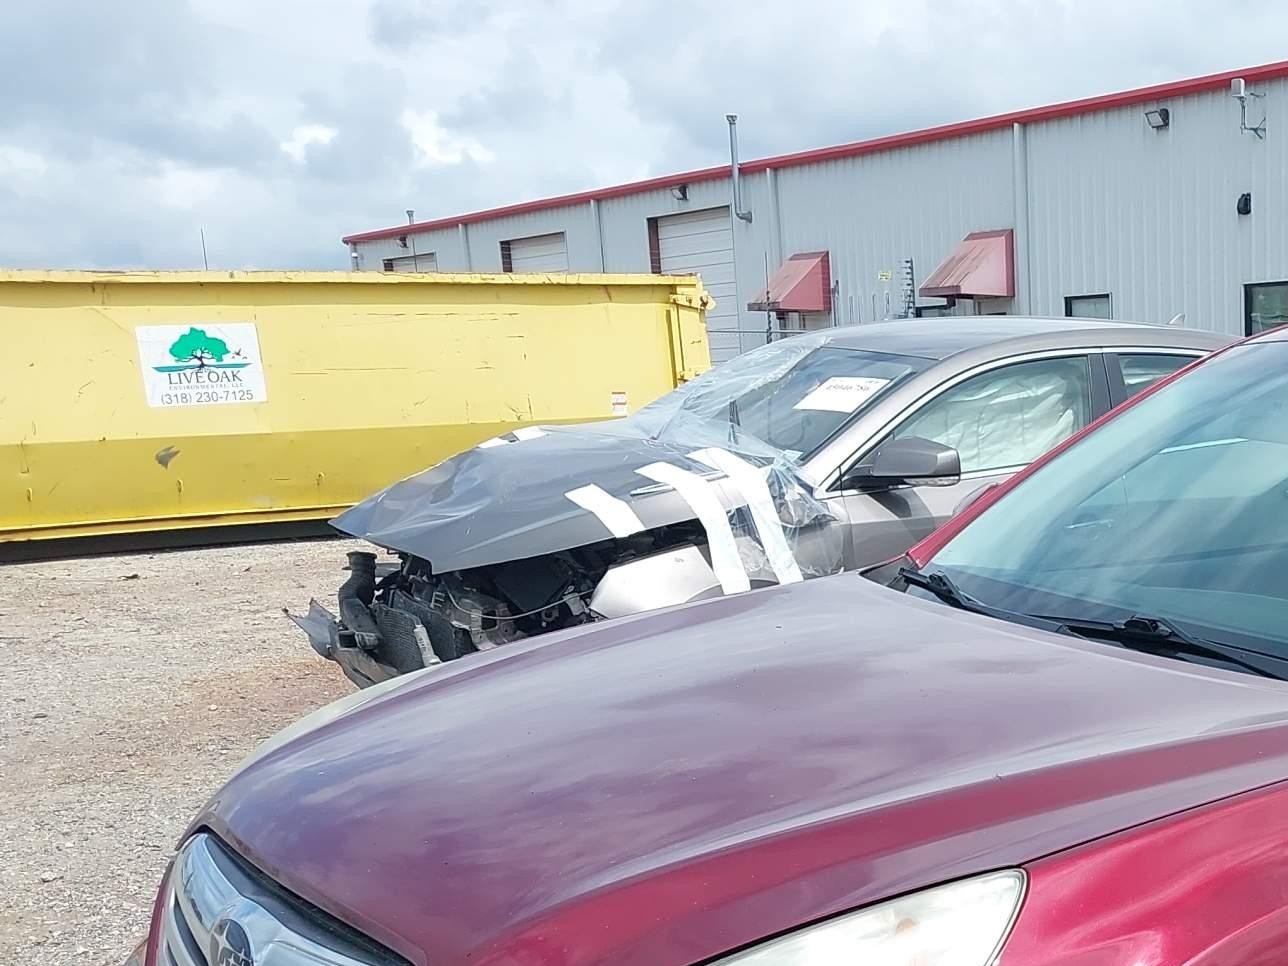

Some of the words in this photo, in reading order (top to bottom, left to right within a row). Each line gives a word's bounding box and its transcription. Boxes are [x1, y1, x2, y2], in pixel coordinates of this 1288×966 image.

[168, 371, 206, 385] LIVE
[207, 369, 243, 384] OAK
[161, 392, 192, 405] (318)
[195, 389, 254, 403] 230-7125
